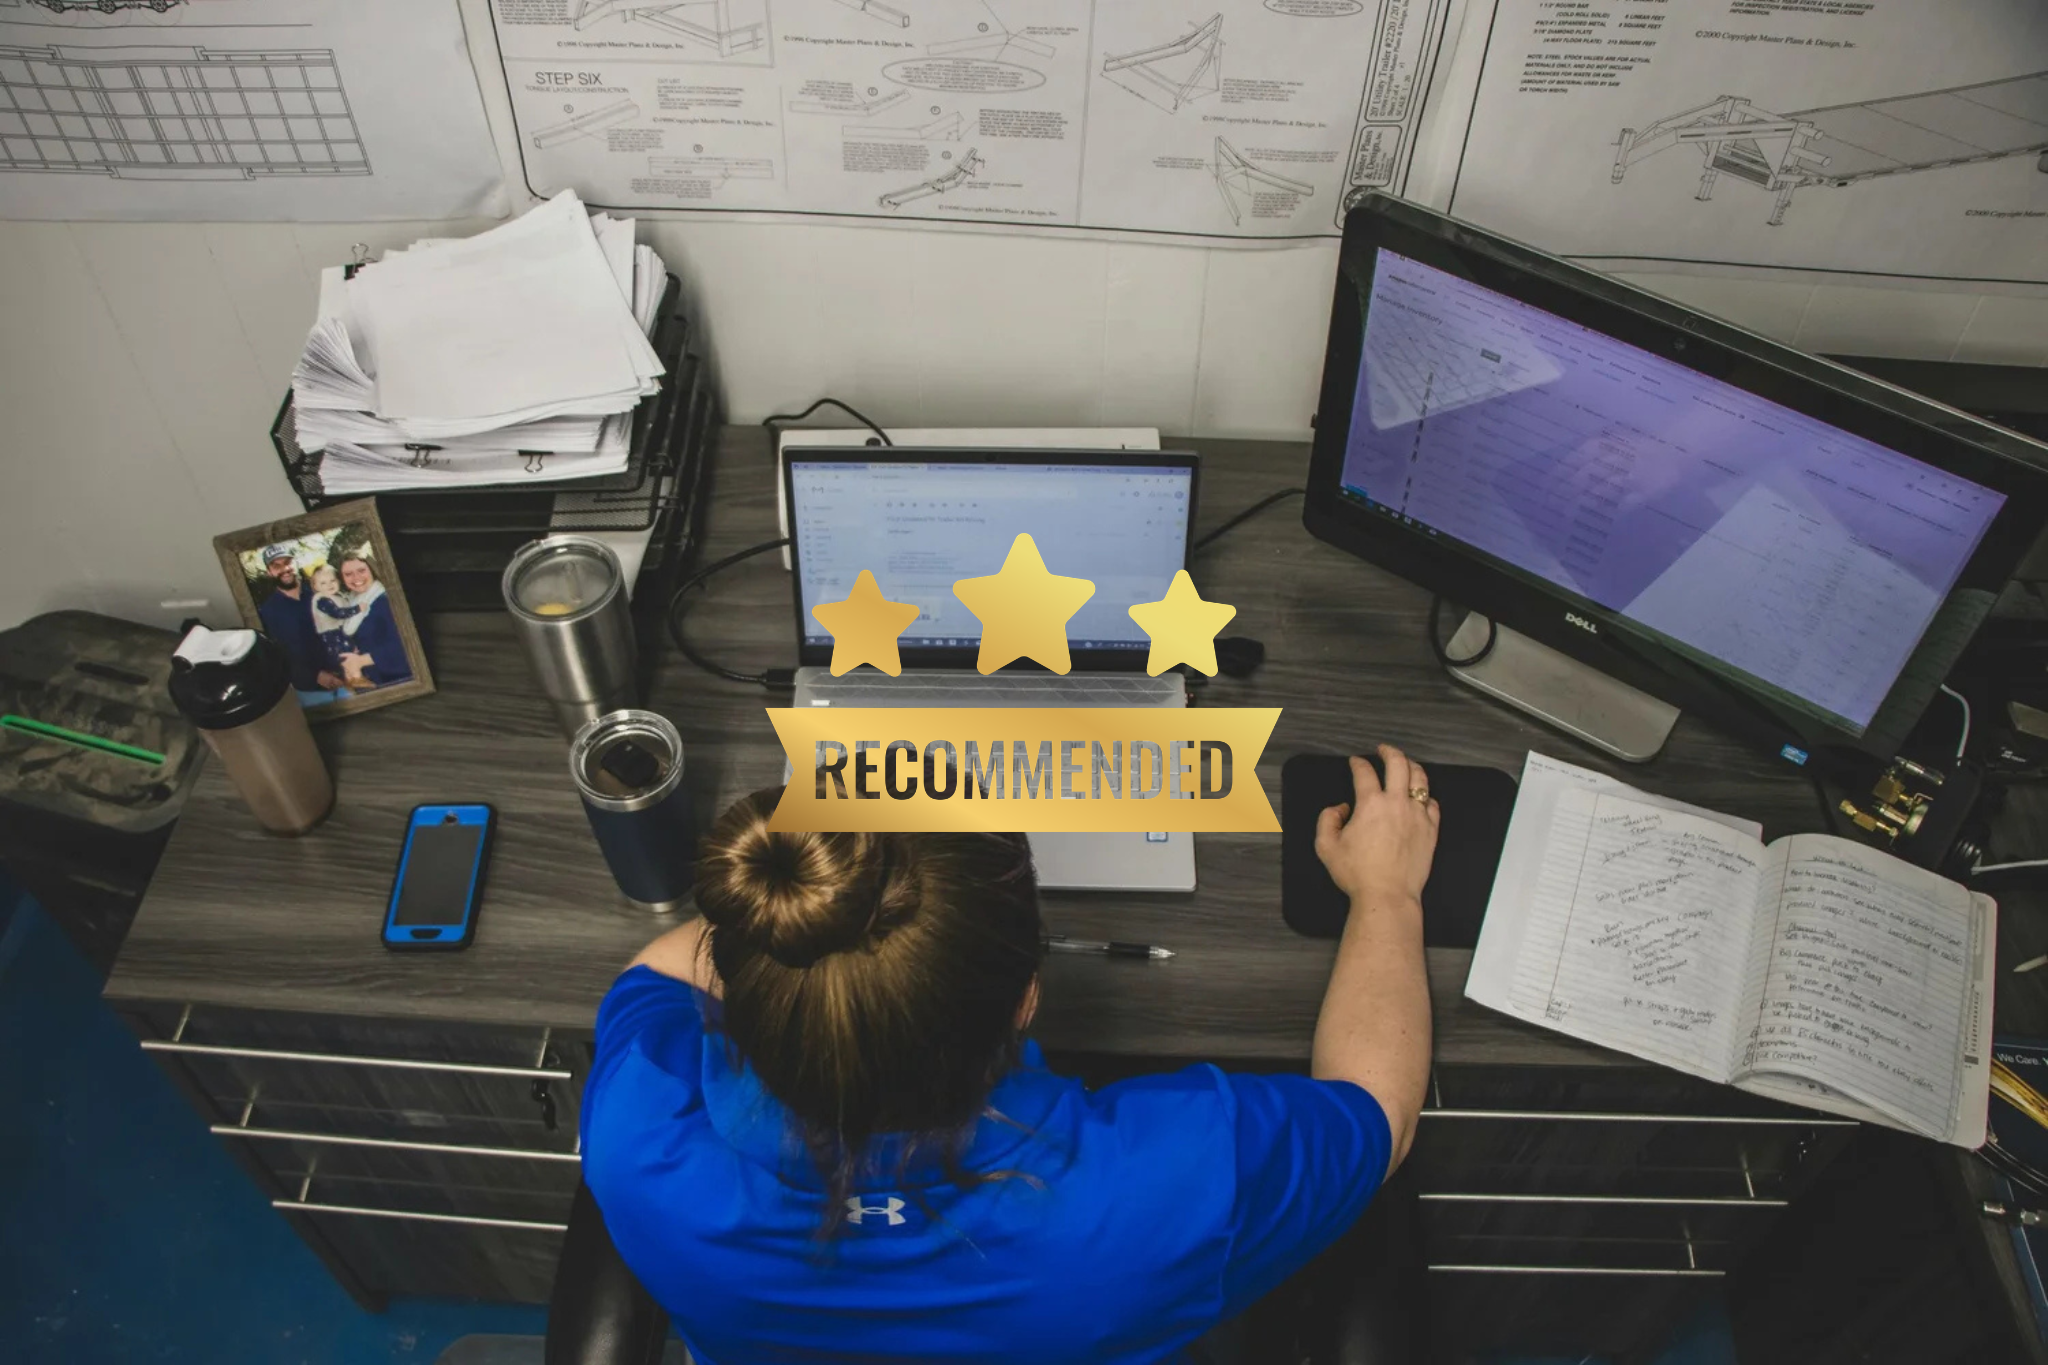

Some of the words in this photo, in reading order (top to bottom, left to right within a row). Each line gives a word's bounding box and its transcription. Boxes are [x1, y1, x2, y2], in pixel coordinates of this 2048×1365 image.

[1744, 2, 1780, 10] INSPECTION
[1721, 31, 1758, 43] Copyright
[1759, 33, 1784, 43] Master
[1785, 36, 1804, 45] Plans
[1378, 50, 1391, 77] Trailer
[535, 71, 574, 85] STEP
[578, 72, 603, 86] SIX
[1372, 79, 1387, 104] Utility
[1360, 130, 1372, 152] Plans
[1354, 154, 1367, 180] Master
[1376, 293, 1406, 310] Manage
[1406, 305, 1443, 325] Inventory
[1565, 612, 1598, 634] DELL
[1996, 1053, 2014, 1063] We
[2015, 1054, 2041, 1066] Care.
